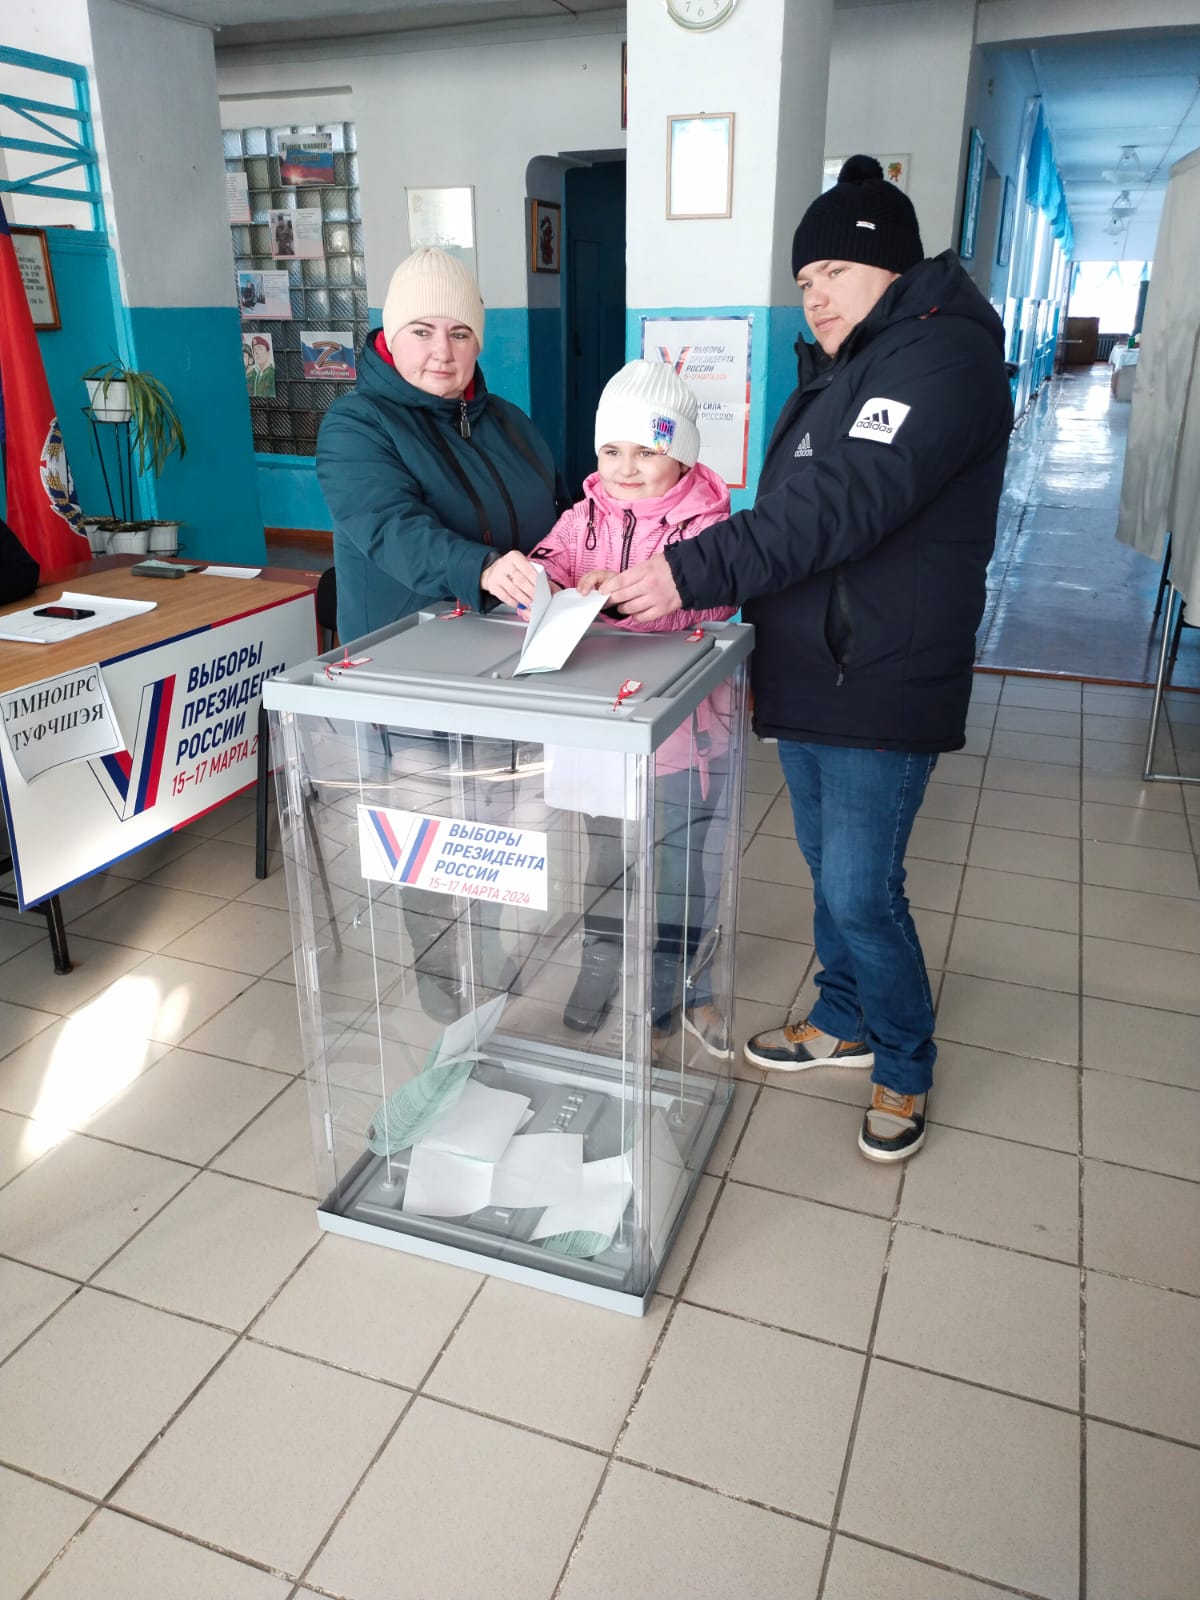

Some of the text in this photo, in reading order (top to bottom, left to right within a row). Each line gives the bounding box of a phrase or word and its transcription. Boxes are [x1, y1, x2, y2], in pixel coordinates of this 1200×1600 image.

[685, 364, 715, 373] РОССИИ
[856, 420, 894, 434] adidas
[187, 641, 263, 693] ВЫБОРЫ
[6, 675, 97, 721] ЛМНОПРС
[12, 703, 104, 751] ТУФЧШЭЯ
[176, 711, 247, 765] РОССИИ
[209, 744, 249, 780] МАРТА
[449, 823, 523, 847] ВЫБОРЫ
[441, 842, 545, 871] ПРЕЗИДЕНТА
[434, 860, 500, 883] РОССИИ
[461, 883, 500, 899] МАРТА
[502, 890, 530, 904] 2024
